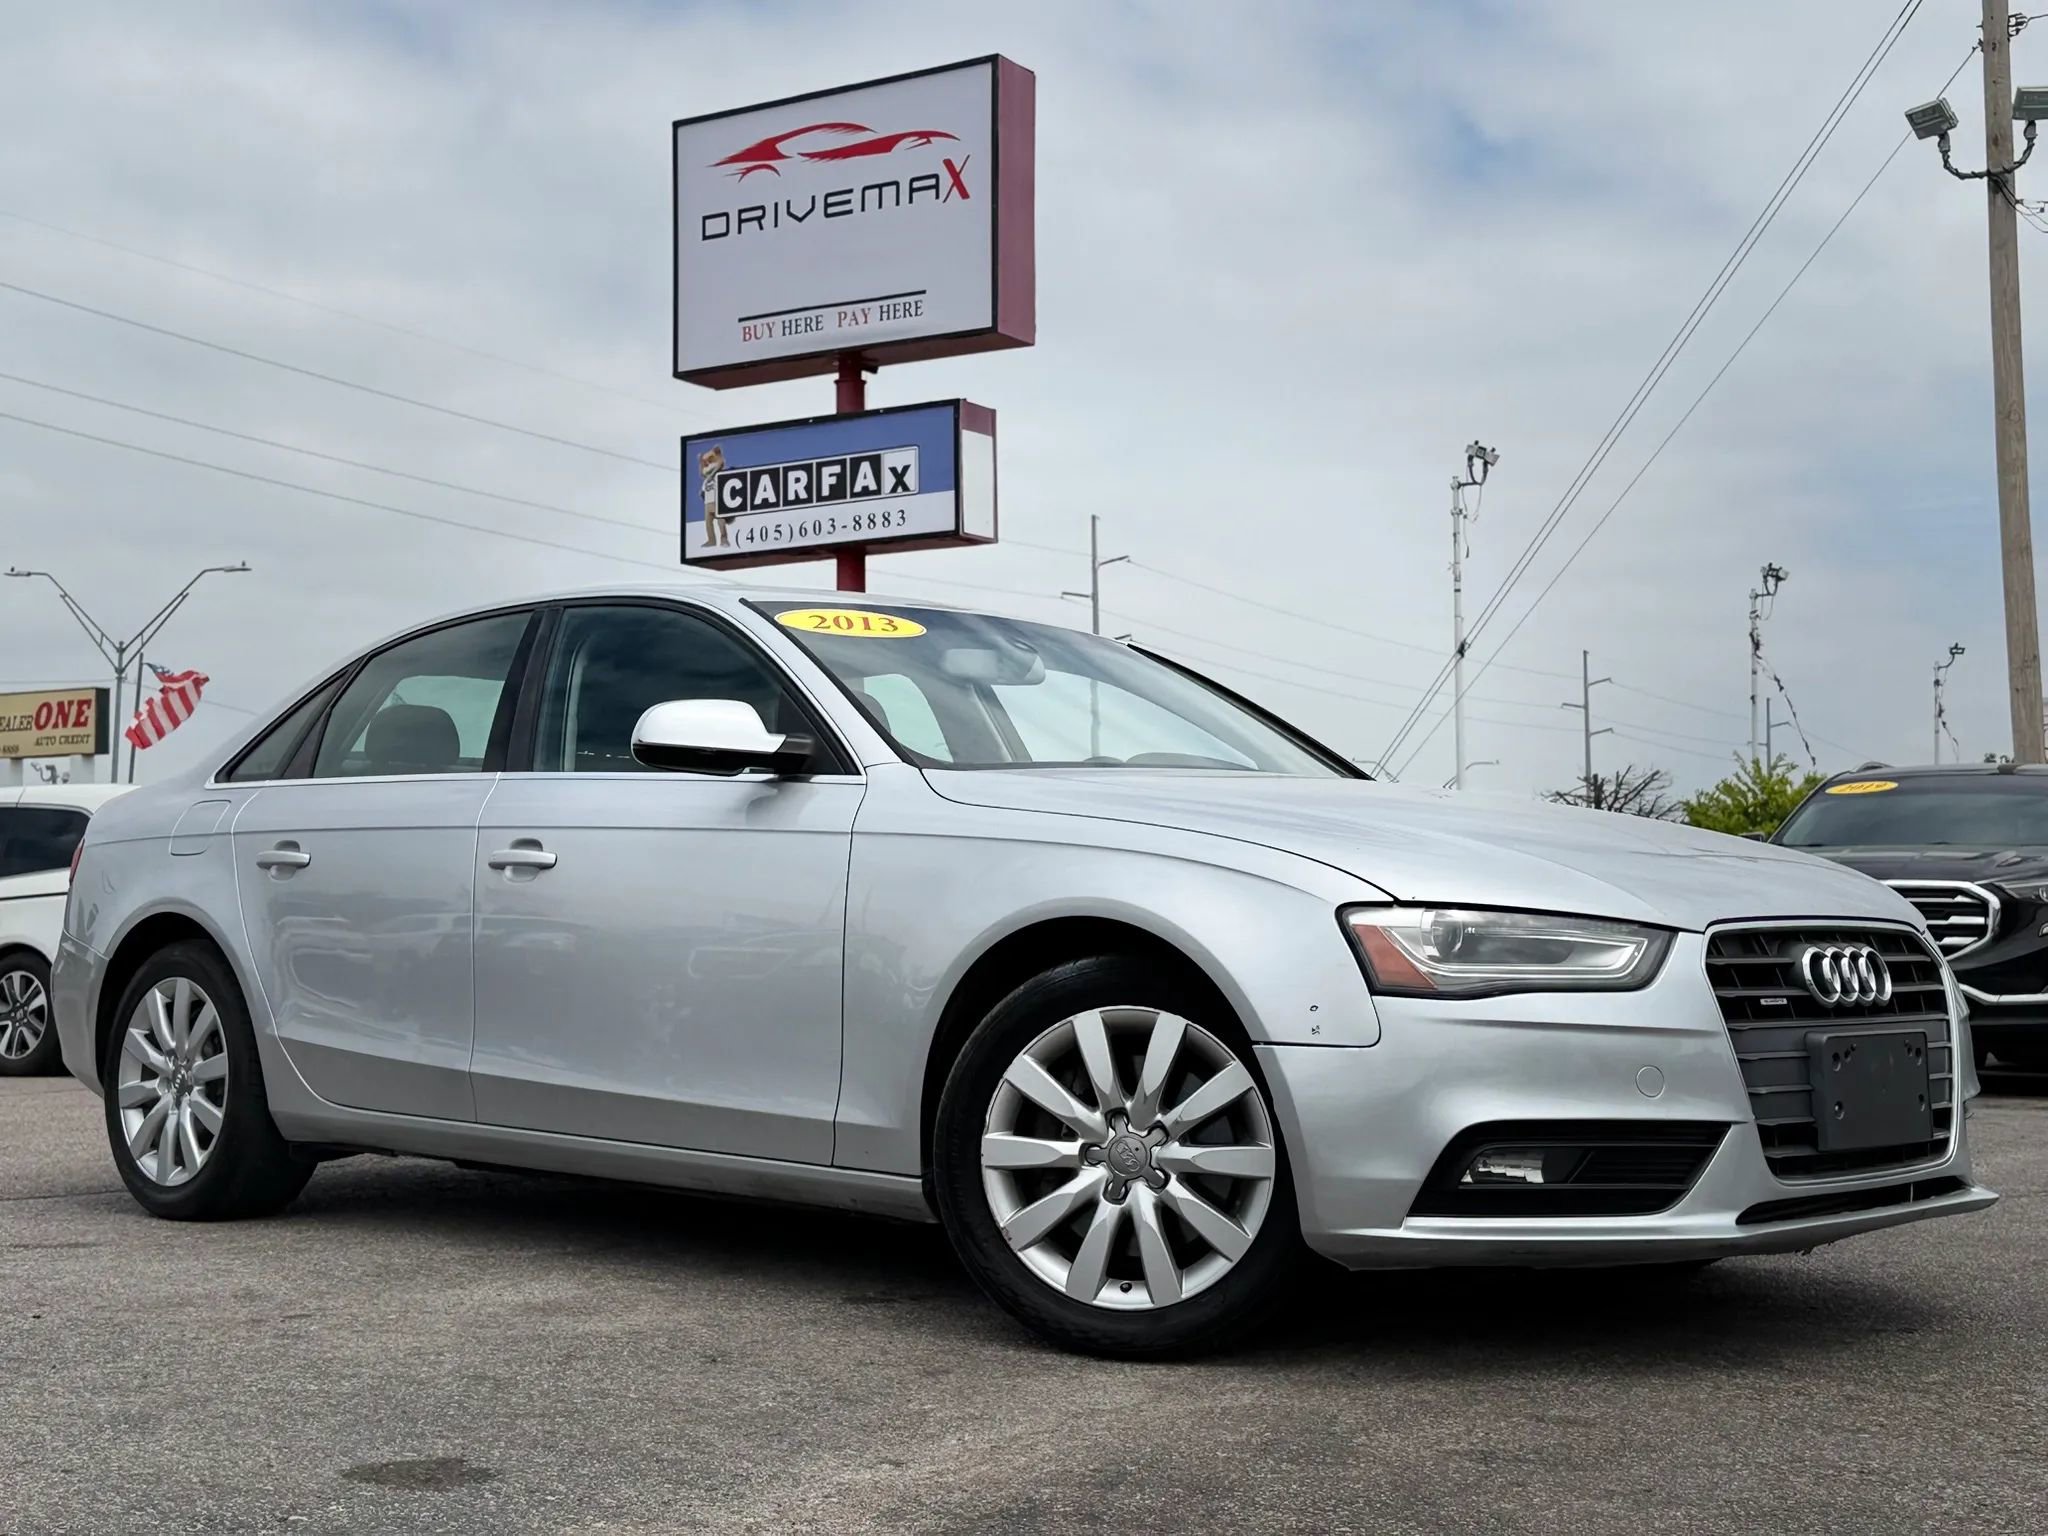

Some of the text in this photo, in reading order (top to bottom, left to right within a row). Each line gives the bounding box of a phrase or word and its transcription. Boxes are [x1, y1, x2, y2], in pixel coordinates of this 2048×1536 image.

[701, 154, 971, 241] DRIVEMAX
[741, 300, 924, 343] BUY HERE PAY HERE
[722, 459, 912, 509] CARFAX
[735, 508, 907, 549] (405)603-8883
[807, 614, 899, 633] 2013
[34, 698, 92, 731] ONE
[34, 735, 57, 746] AUTO
